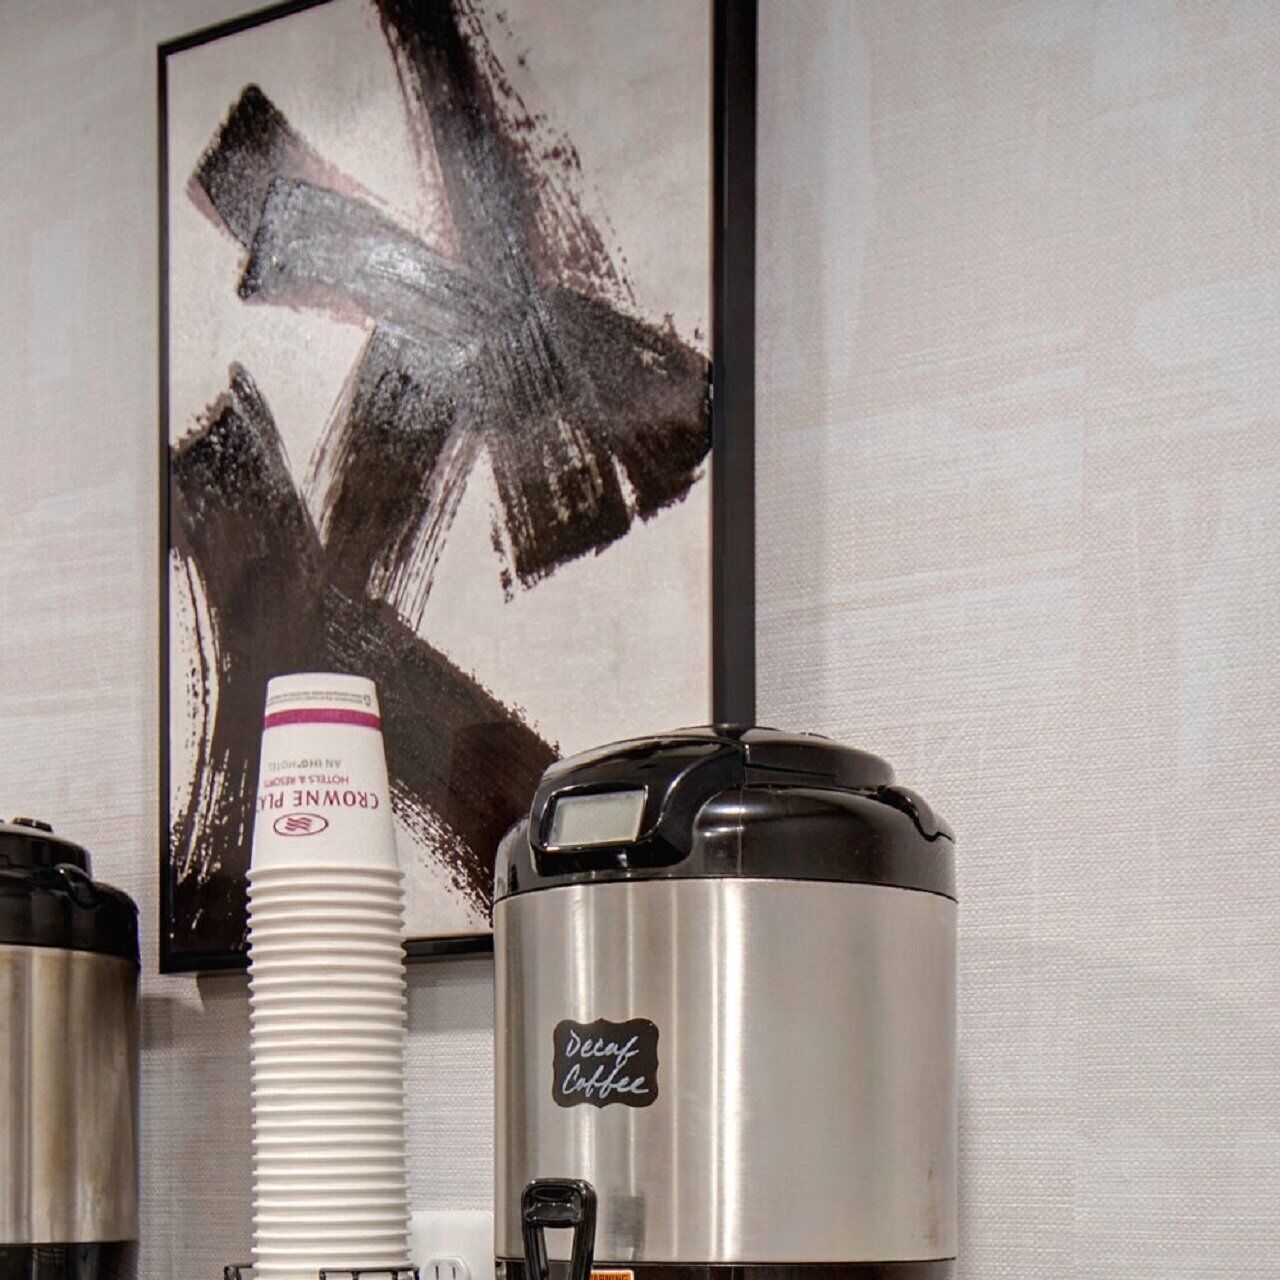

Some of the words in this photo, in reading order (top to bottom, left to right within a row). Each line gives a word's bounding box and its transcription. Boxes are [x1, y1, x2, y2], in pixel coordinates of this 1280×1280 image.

[324, 758, 342, 770] AN
[298, 776, 307, 785] &
[310, 775, 350, 785] HOTELS
[293, 790, 380, 810] CROWNE
[565, 1029, 639, 1068] Decaf
[562, 1064, 649, 1099] Coffee
